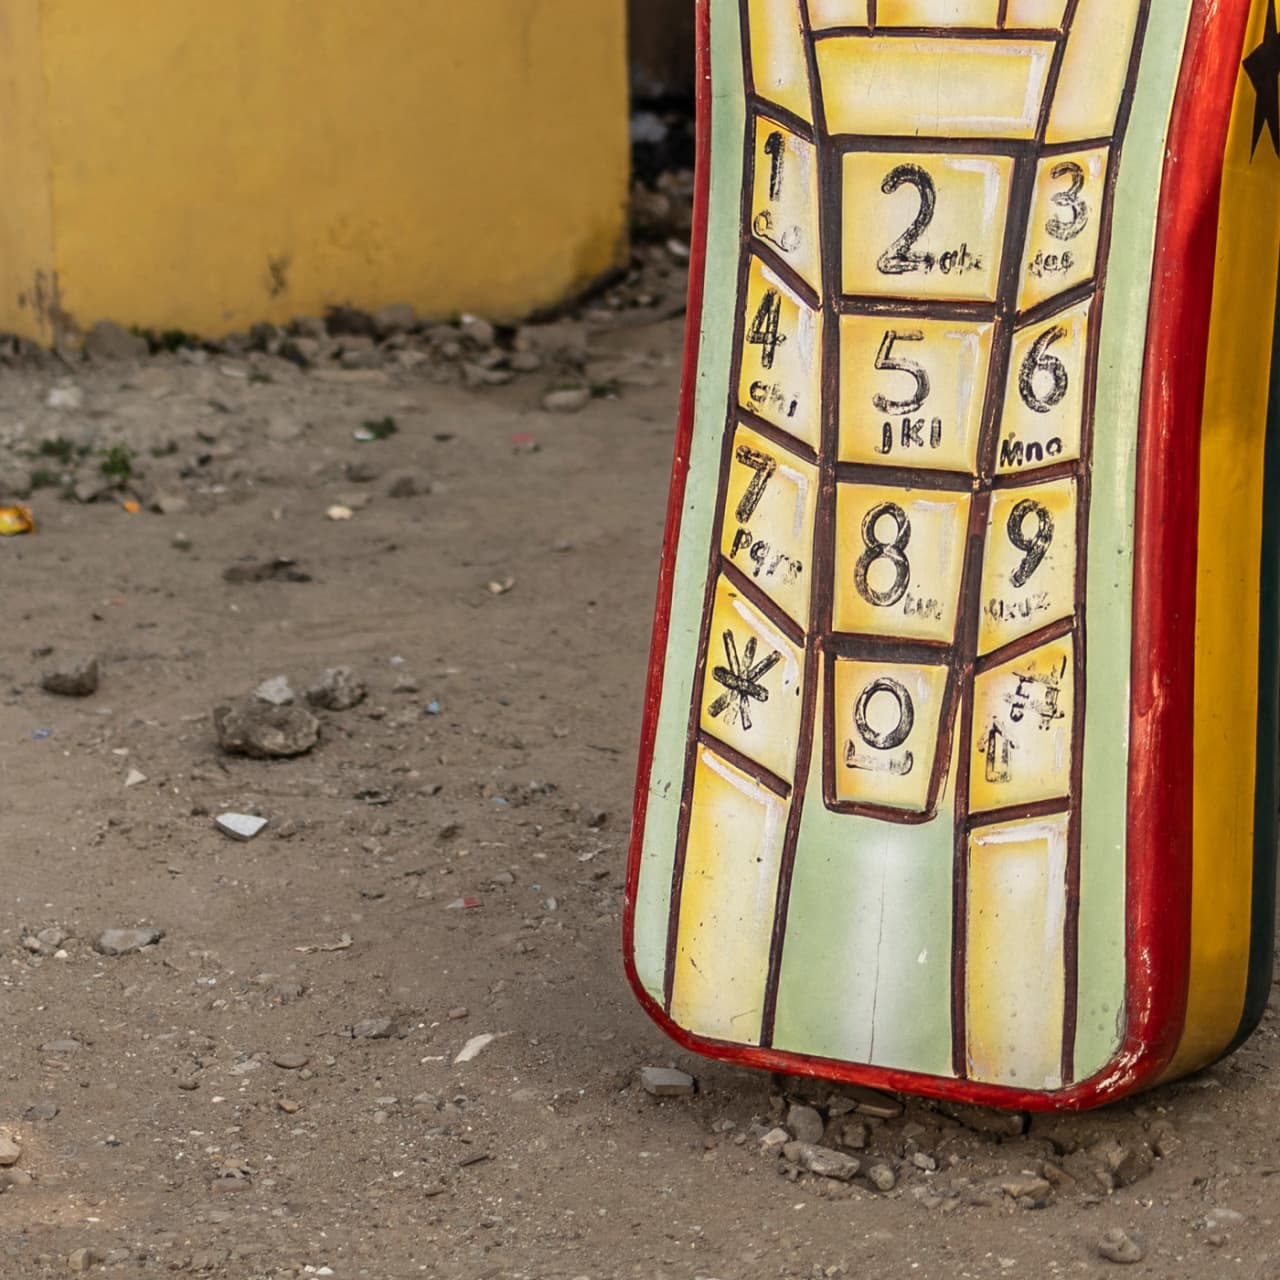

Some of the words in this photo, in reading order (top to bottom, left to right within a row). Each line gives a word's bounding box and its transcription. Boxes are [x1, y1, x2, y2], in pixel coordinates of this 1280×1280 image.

[764, 131, 786, 202] 1
[1045, 161, 1088, 240] 3
[877, 163, 937, 274] 2
[746, 288, 786, 369] 4
[1019, 325, 1069, 413] 6
[872, 330, 930, 415] 5
[735, 444, 776, 524] 7
[854, 501, 912, 607] 8
[1007, 499, 1054, 588] 9
